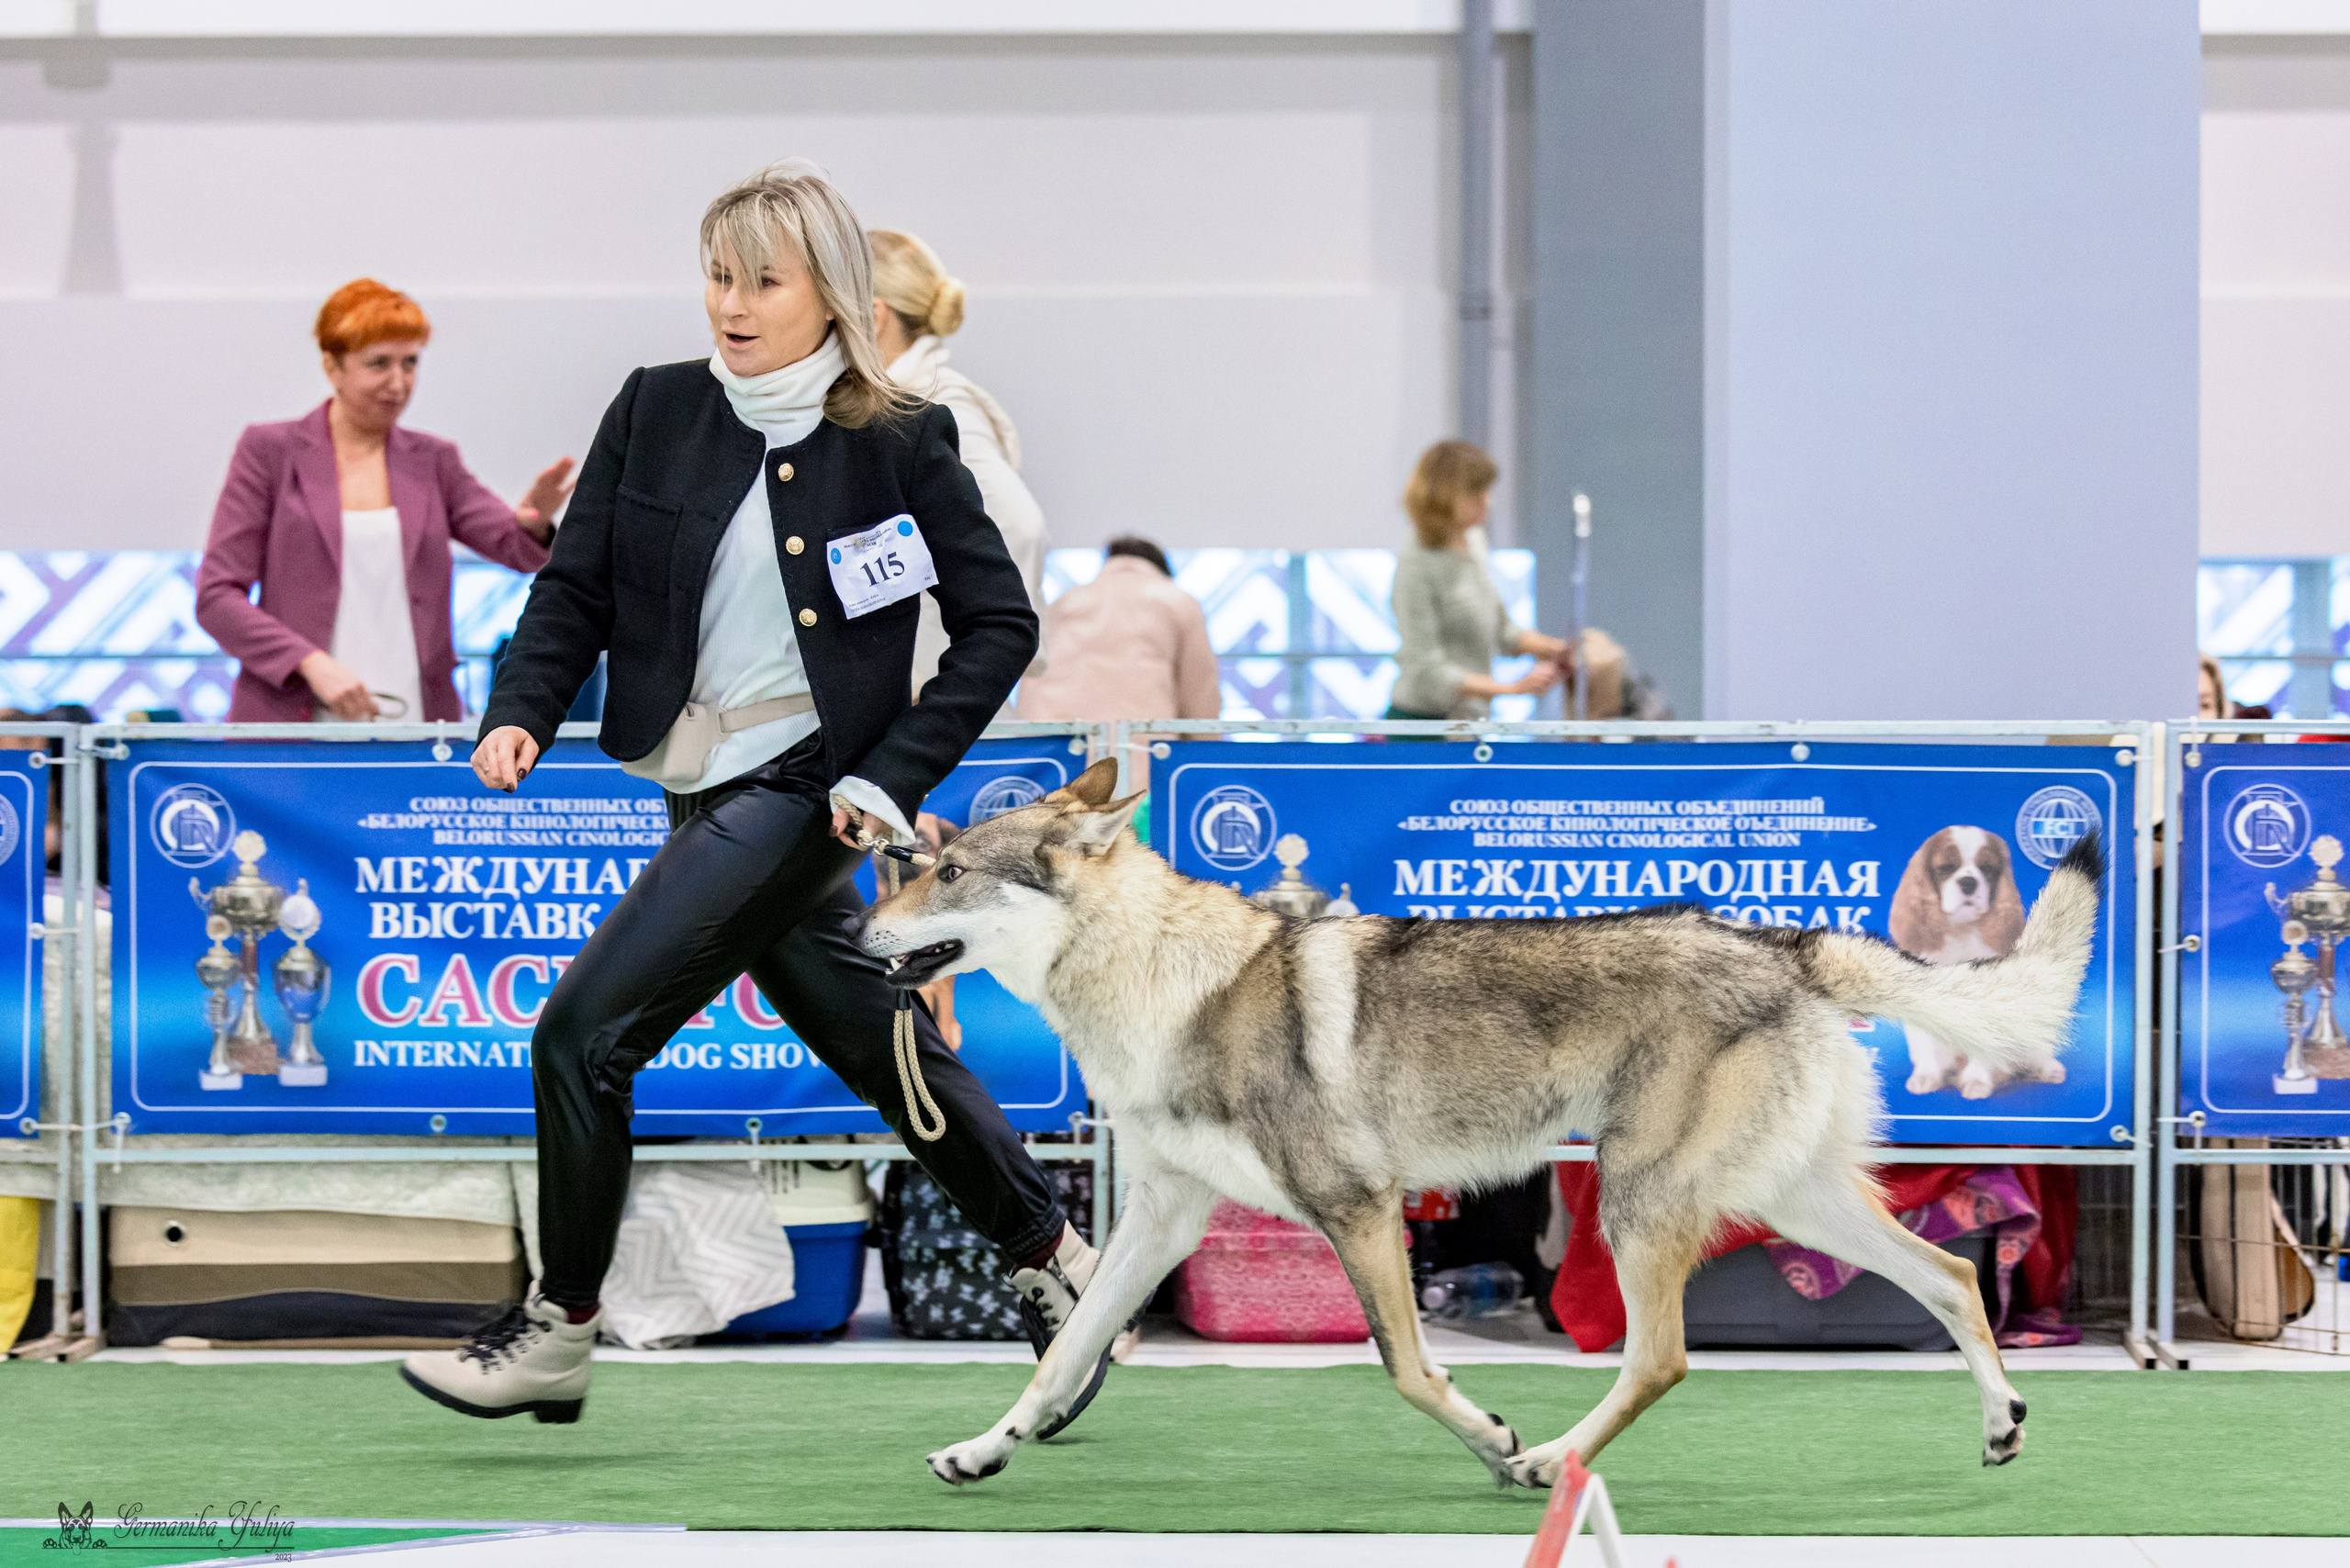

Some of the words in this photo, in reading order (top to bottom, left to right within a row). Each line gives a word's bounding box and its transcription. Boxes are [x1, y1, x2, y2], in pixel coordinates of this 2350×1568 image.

[860, 551, 905, 588] 115
[409, 797, 469, 813] СОЮЗ
[471, 797, 633, 814] ОБЩЕСТВЕННЫХ
[1449, 799, 1509, 815] СОЮЗ
[1511, 799, 1674, 815] ОБЩЕСТВЕННЫХ
[509, 814, 670, 831] КИНОЛОГИЧЕСК
[432, 830, 565, 846] BELORUSSIAN
[1473, 832, 1604, 848] BELORUSSIAN
[1606, 832, 1736, 848] CINOLOGICAL
[1739, 831, 1801, 847] UNION
[1393, 858, 1881, 904] МЕЖДУНАРОДНАЯ
